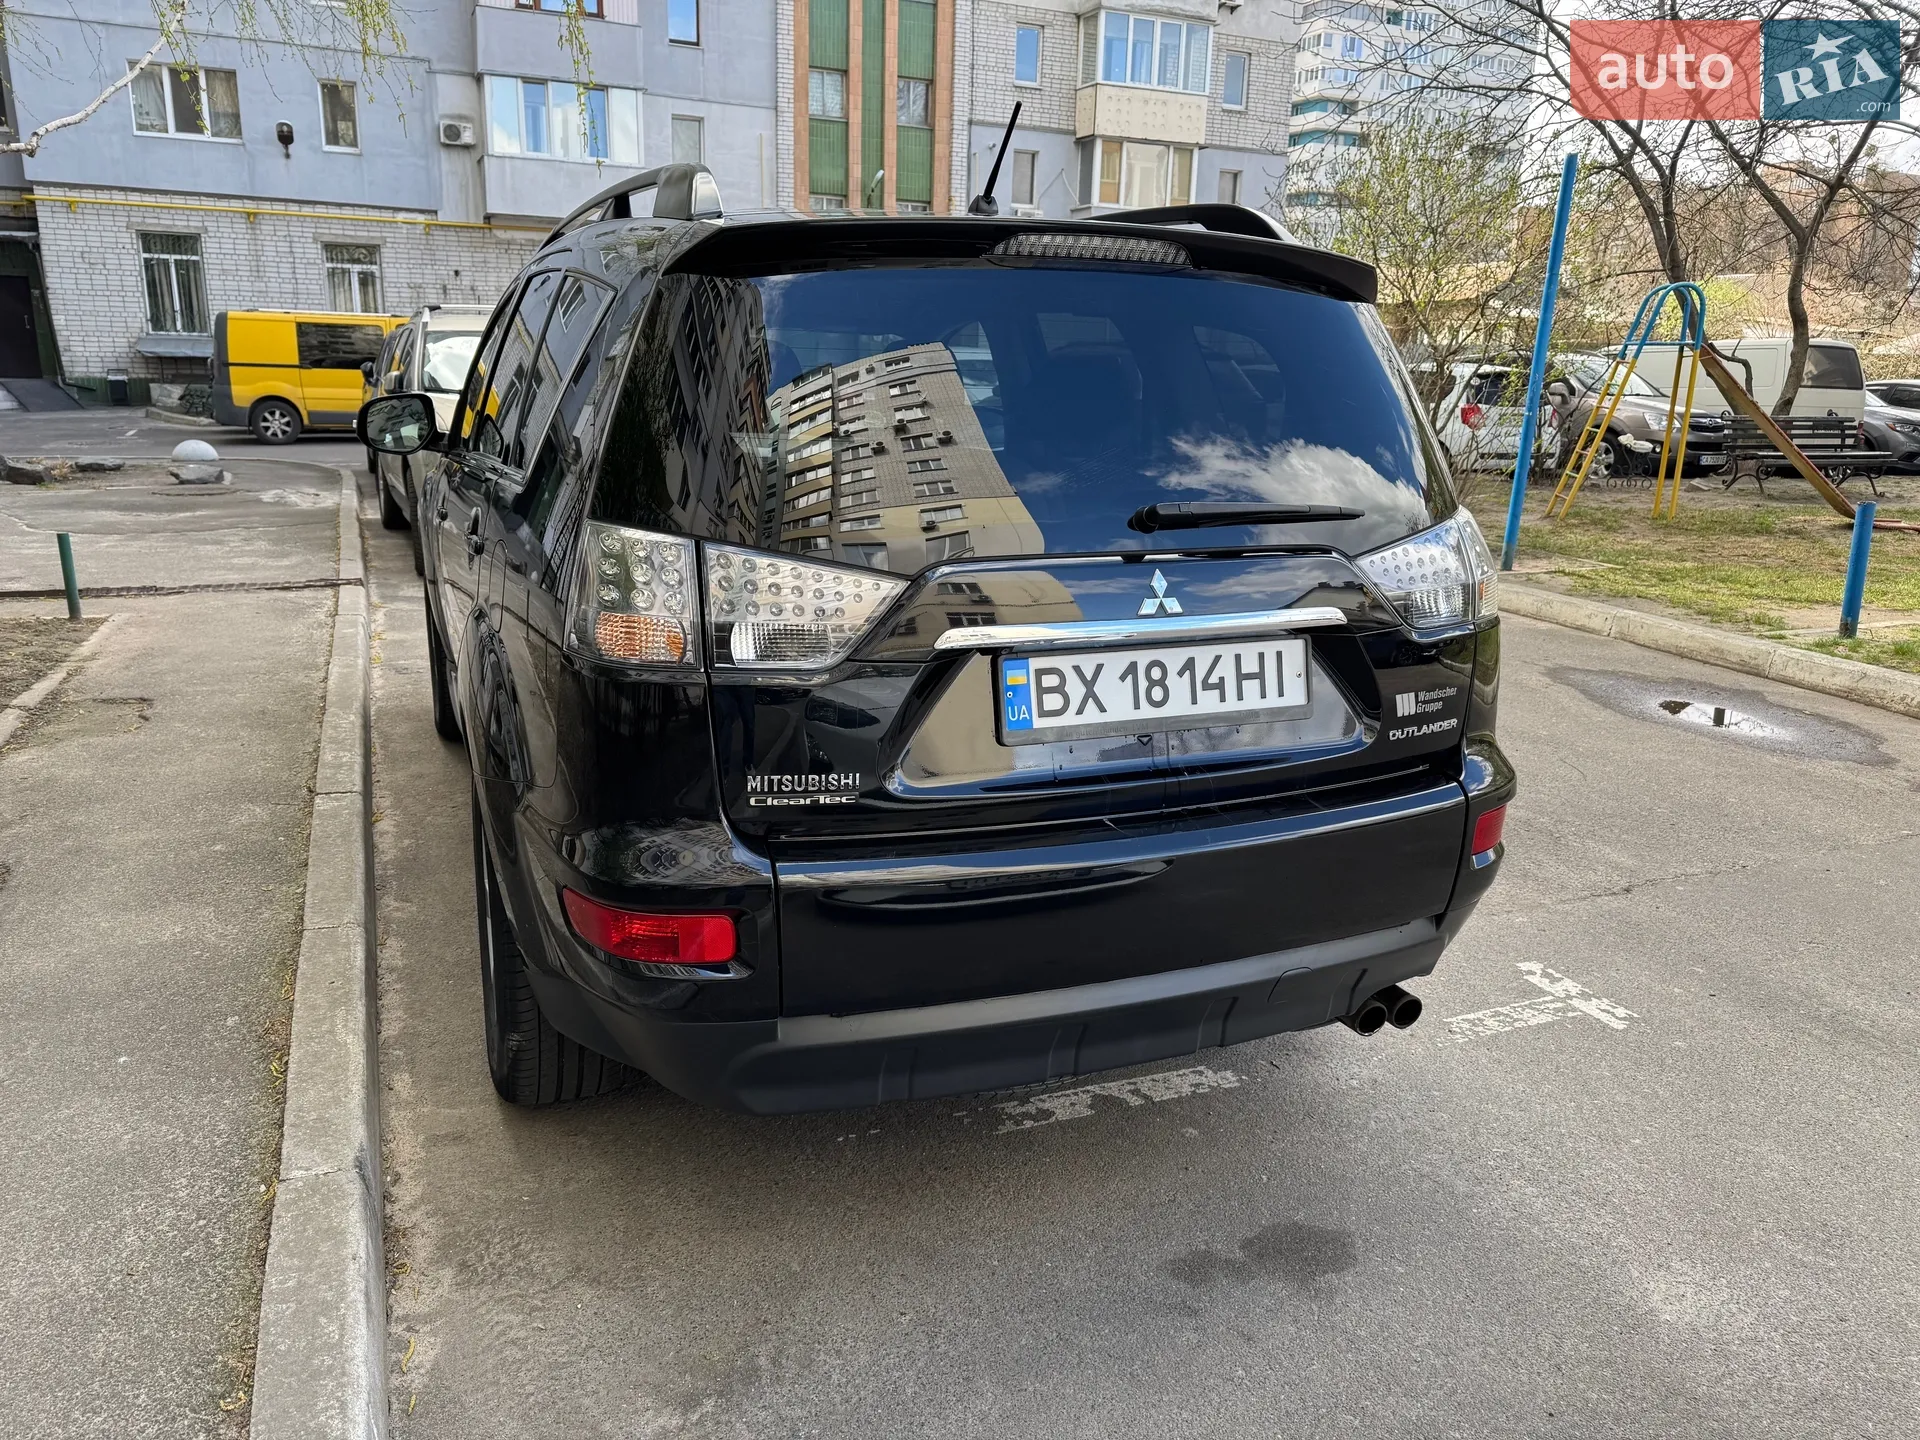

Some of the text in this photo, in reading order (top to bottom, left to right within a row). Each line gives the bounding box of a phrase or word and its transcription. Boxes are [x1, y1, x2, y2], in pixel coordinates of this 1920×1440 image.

[1034, 663, 1107, 719] BX
[1418, 687, 1458, 702] Wandscher
[1008, 705, 1030, 721] UA
[1416, 701, 1443, 713] Gruppe
[1389, 718, 1458, 740] OUTLANDER
[747, 773, 860, 792] MITSUBISHI
[749, 794, 856, 806] ClearTec
